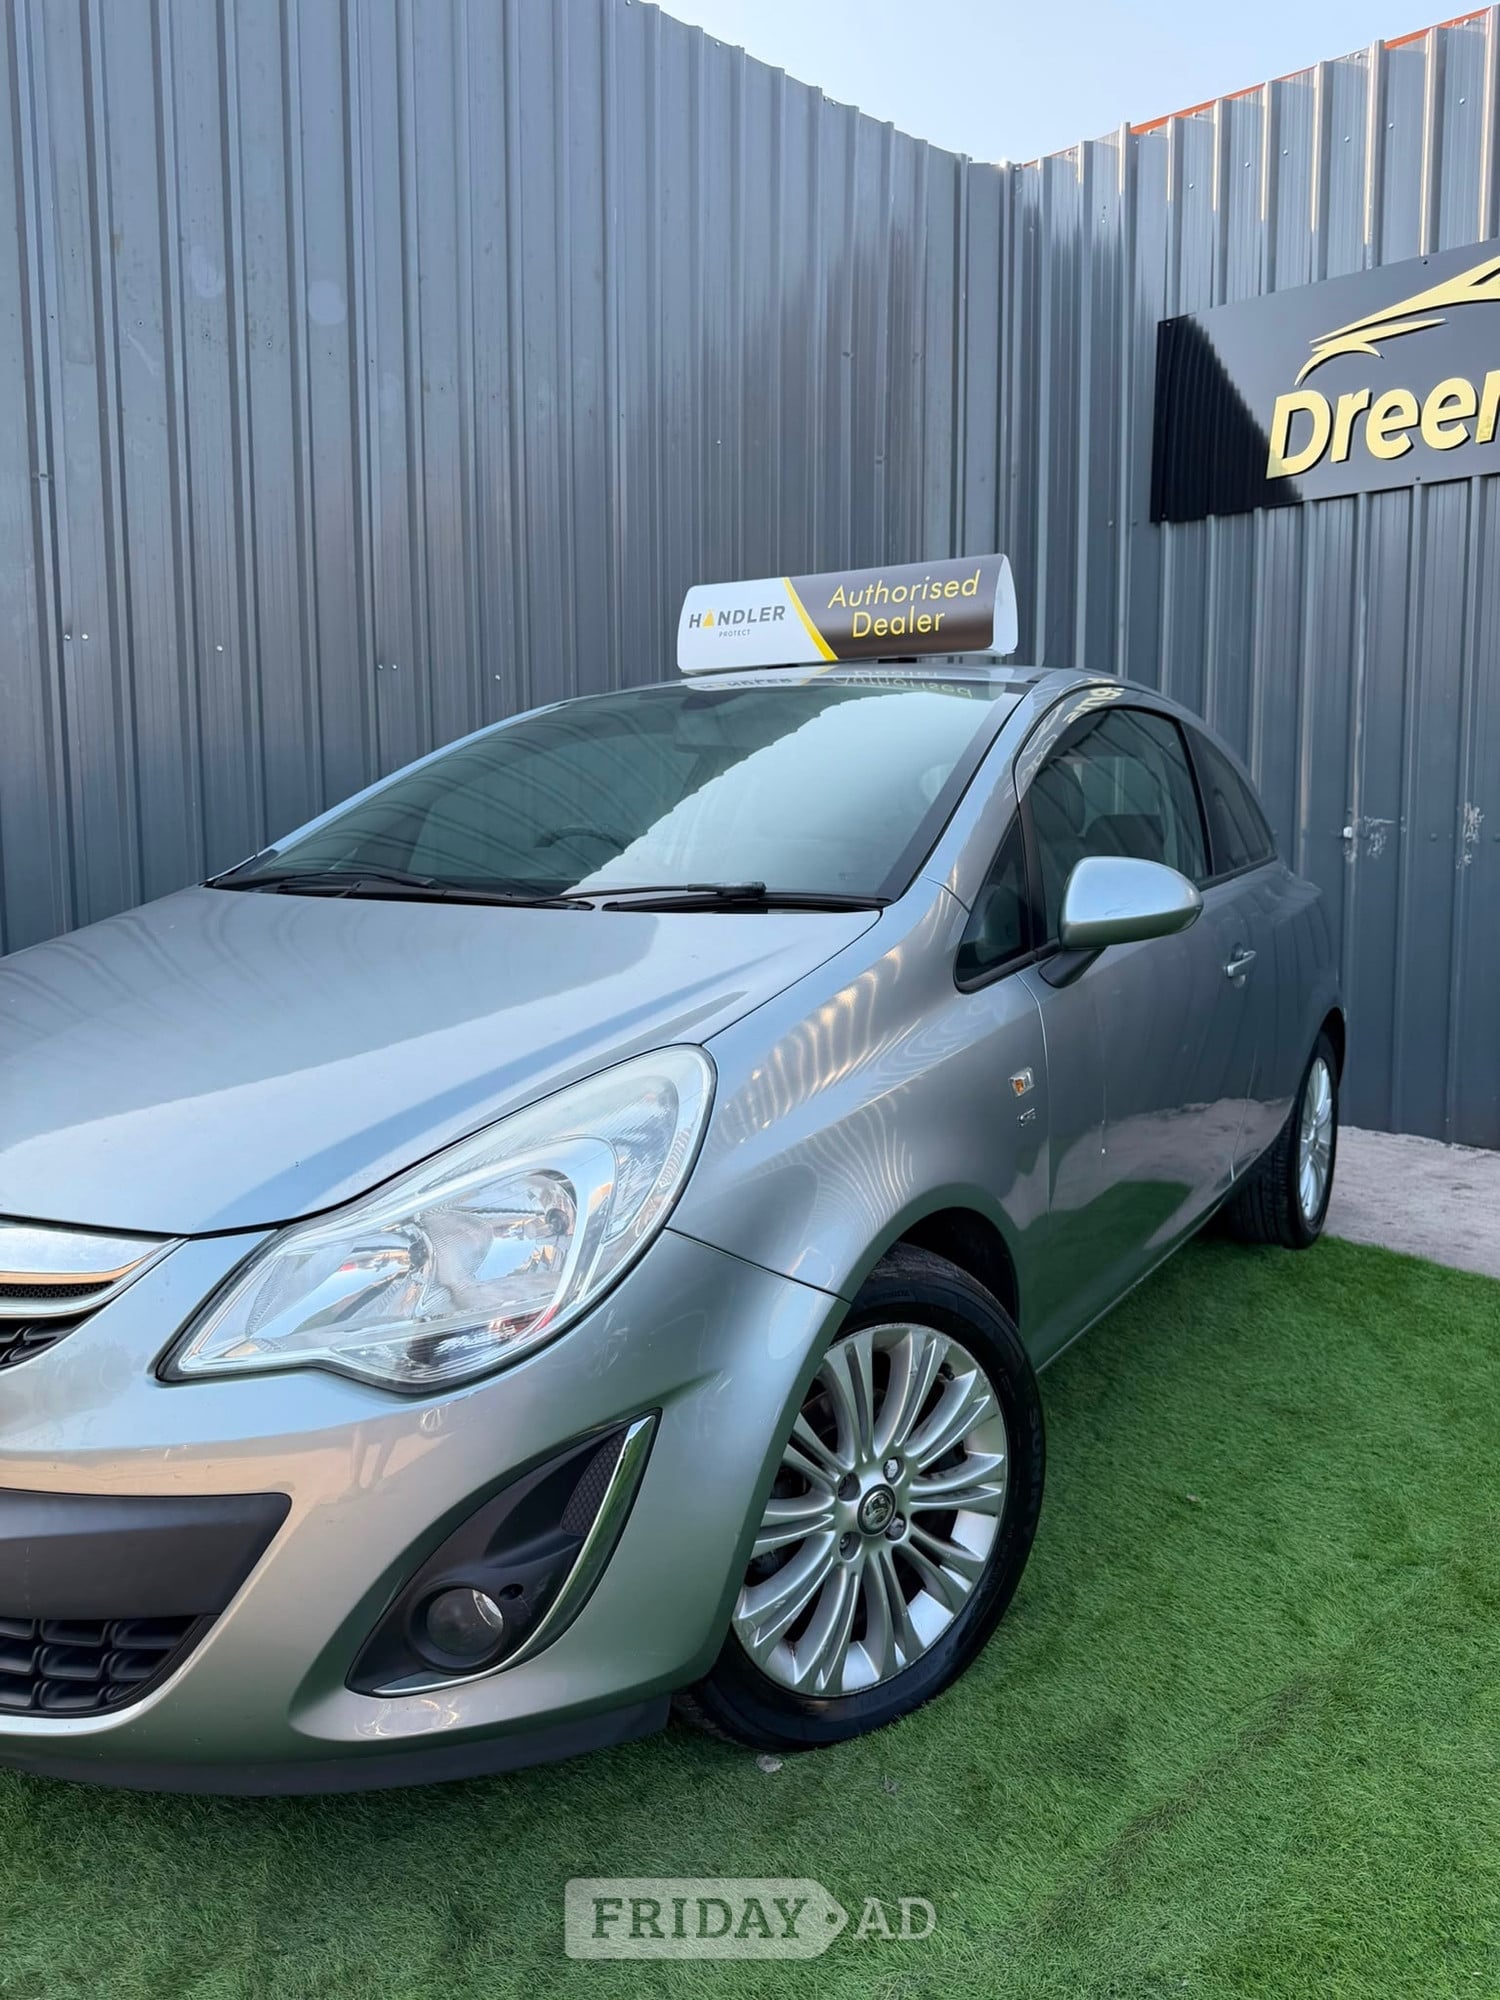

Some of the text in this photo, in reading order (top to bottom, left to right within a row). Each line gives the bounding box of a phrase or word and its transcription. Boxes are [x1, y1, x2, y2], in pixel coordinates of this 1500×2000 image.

[828, 569, 981, 609] Authorised
[688, 605, 785, 629] HANDLER
[852, 605, 945, 638] Dealer
[718, 628, 751, 638] PROTECT
